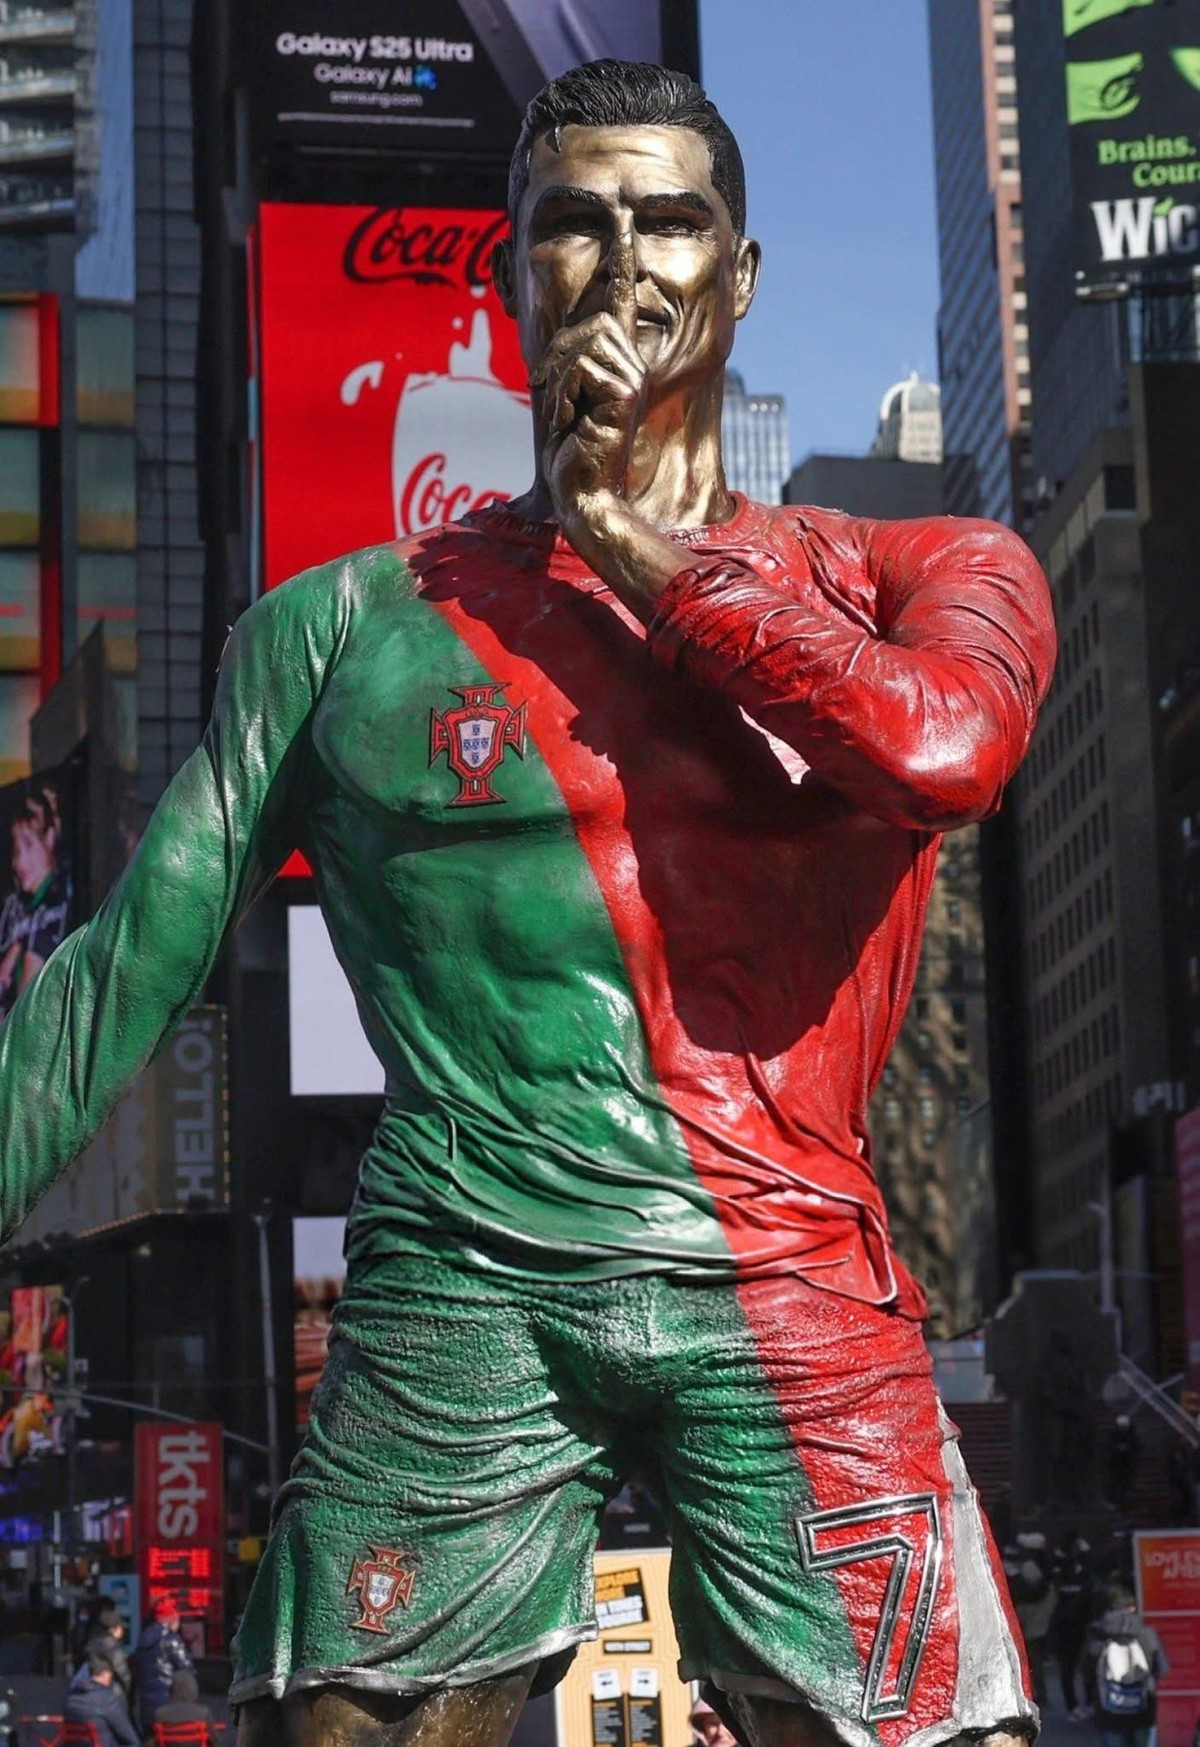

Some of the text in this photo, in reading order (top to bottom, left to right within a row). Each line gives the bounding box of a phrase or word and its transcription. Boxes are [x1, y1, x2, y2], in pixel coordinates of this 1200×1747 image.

[276, 32, 474, 62] Galaxy S25 Ultra
[313, 62, 412, 89] Galaxy AI
[1098, 134, 1196, 165] Brains.
[1133, 162, 1200, 188] Cour
[343, 196, 508, 289] Coca-C
[158, 1430, 210, 1538] tkts
[796, 1491, 942, 1723] 7
